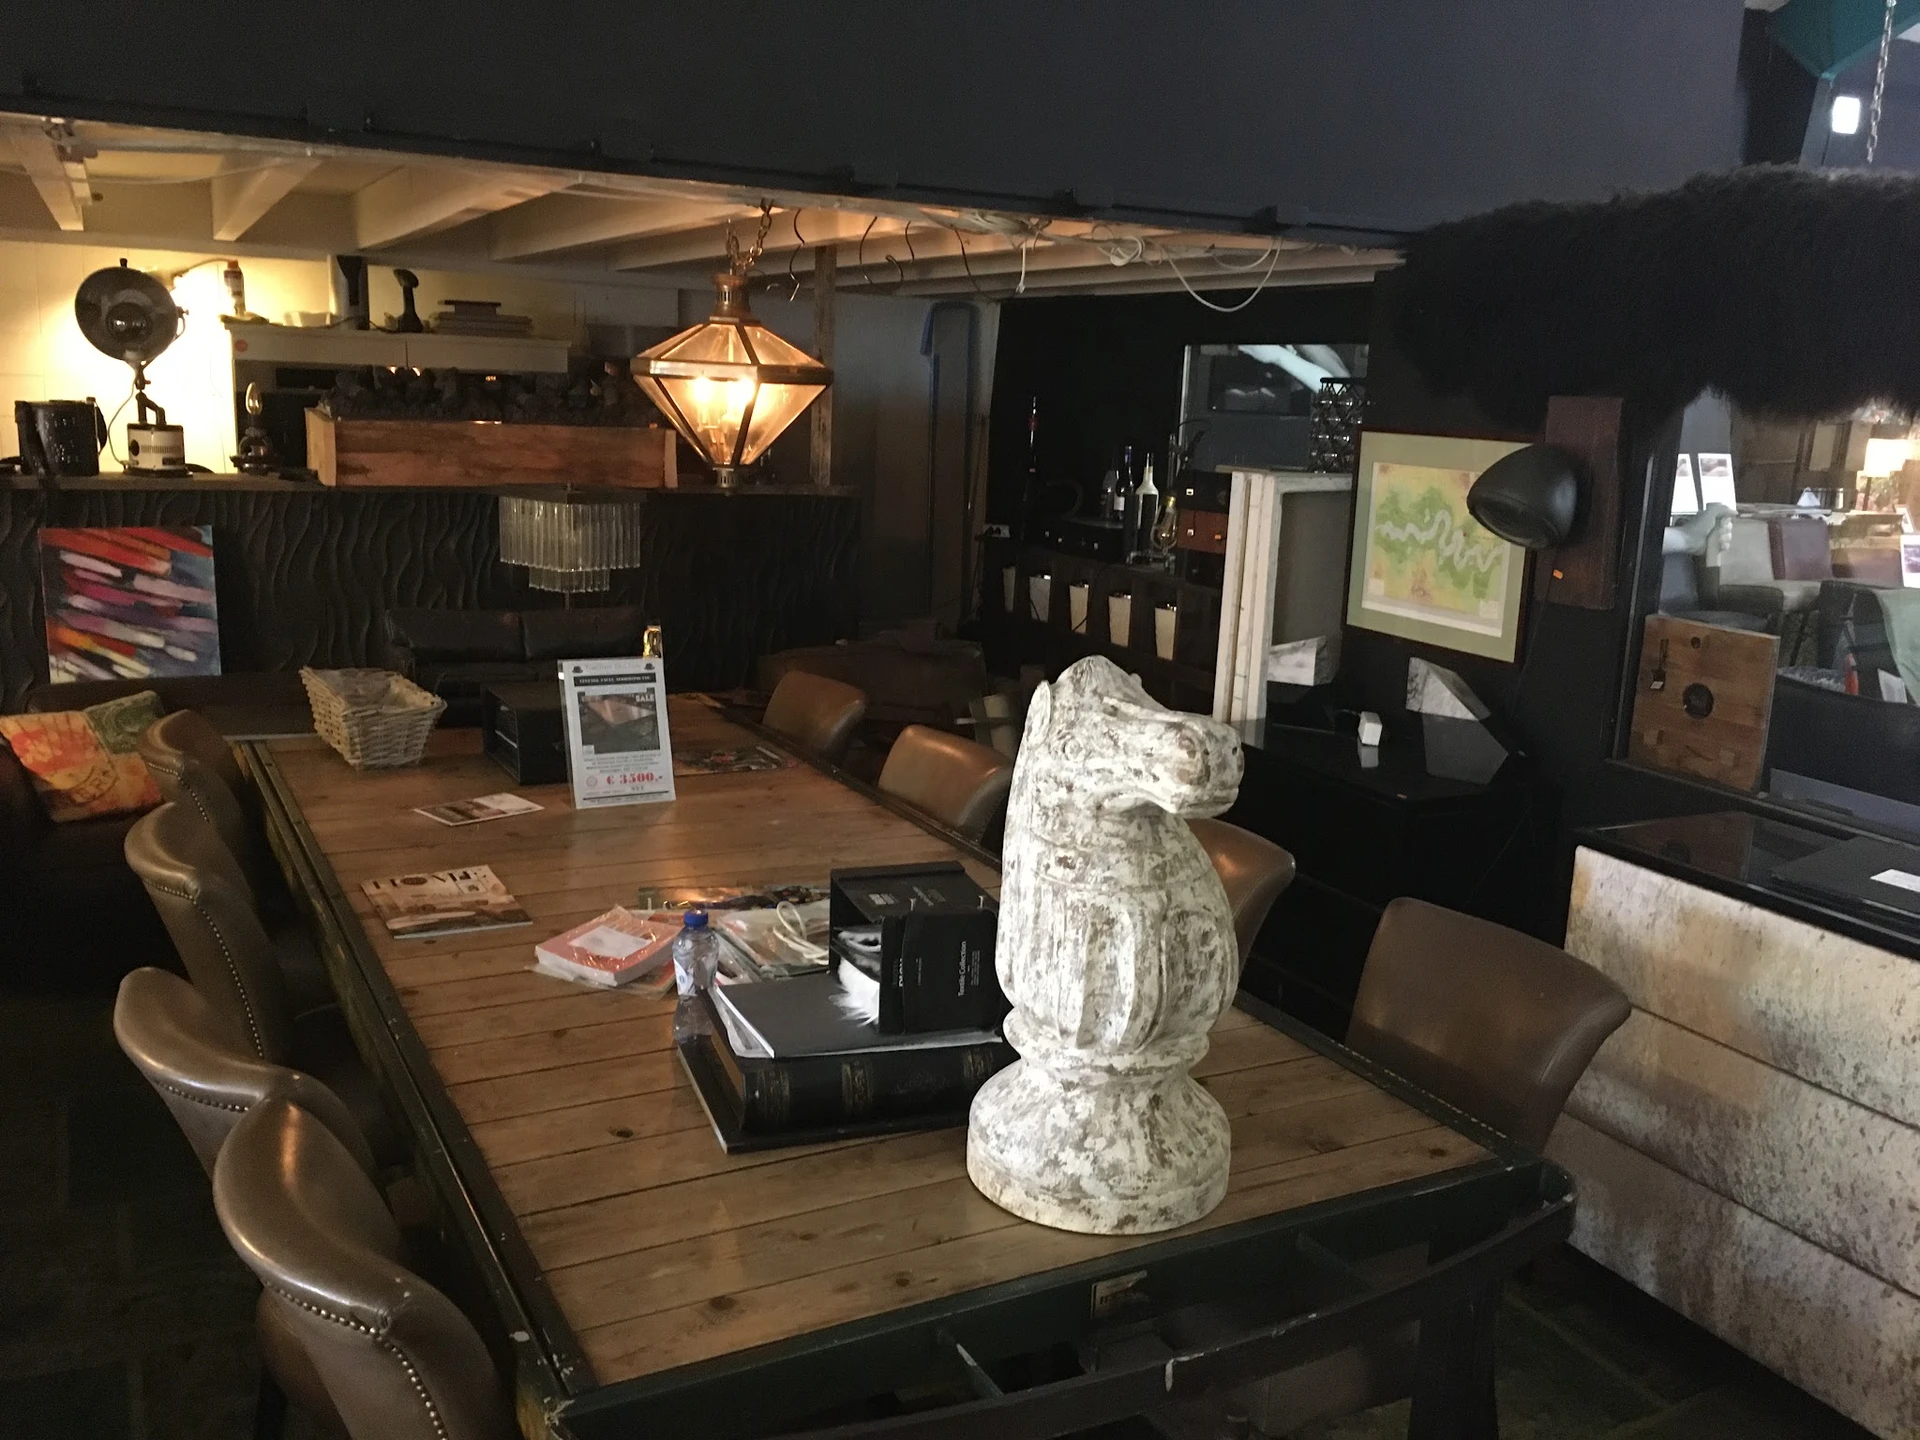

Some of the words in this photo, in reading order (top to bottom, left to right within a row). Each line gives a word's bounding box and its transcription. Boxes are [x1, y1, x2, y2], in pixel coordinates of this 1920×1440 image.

[635, 692, 655, 703] SALE
[606, 775, 615, 785] €
[959, 940, 967, 975] Collection
